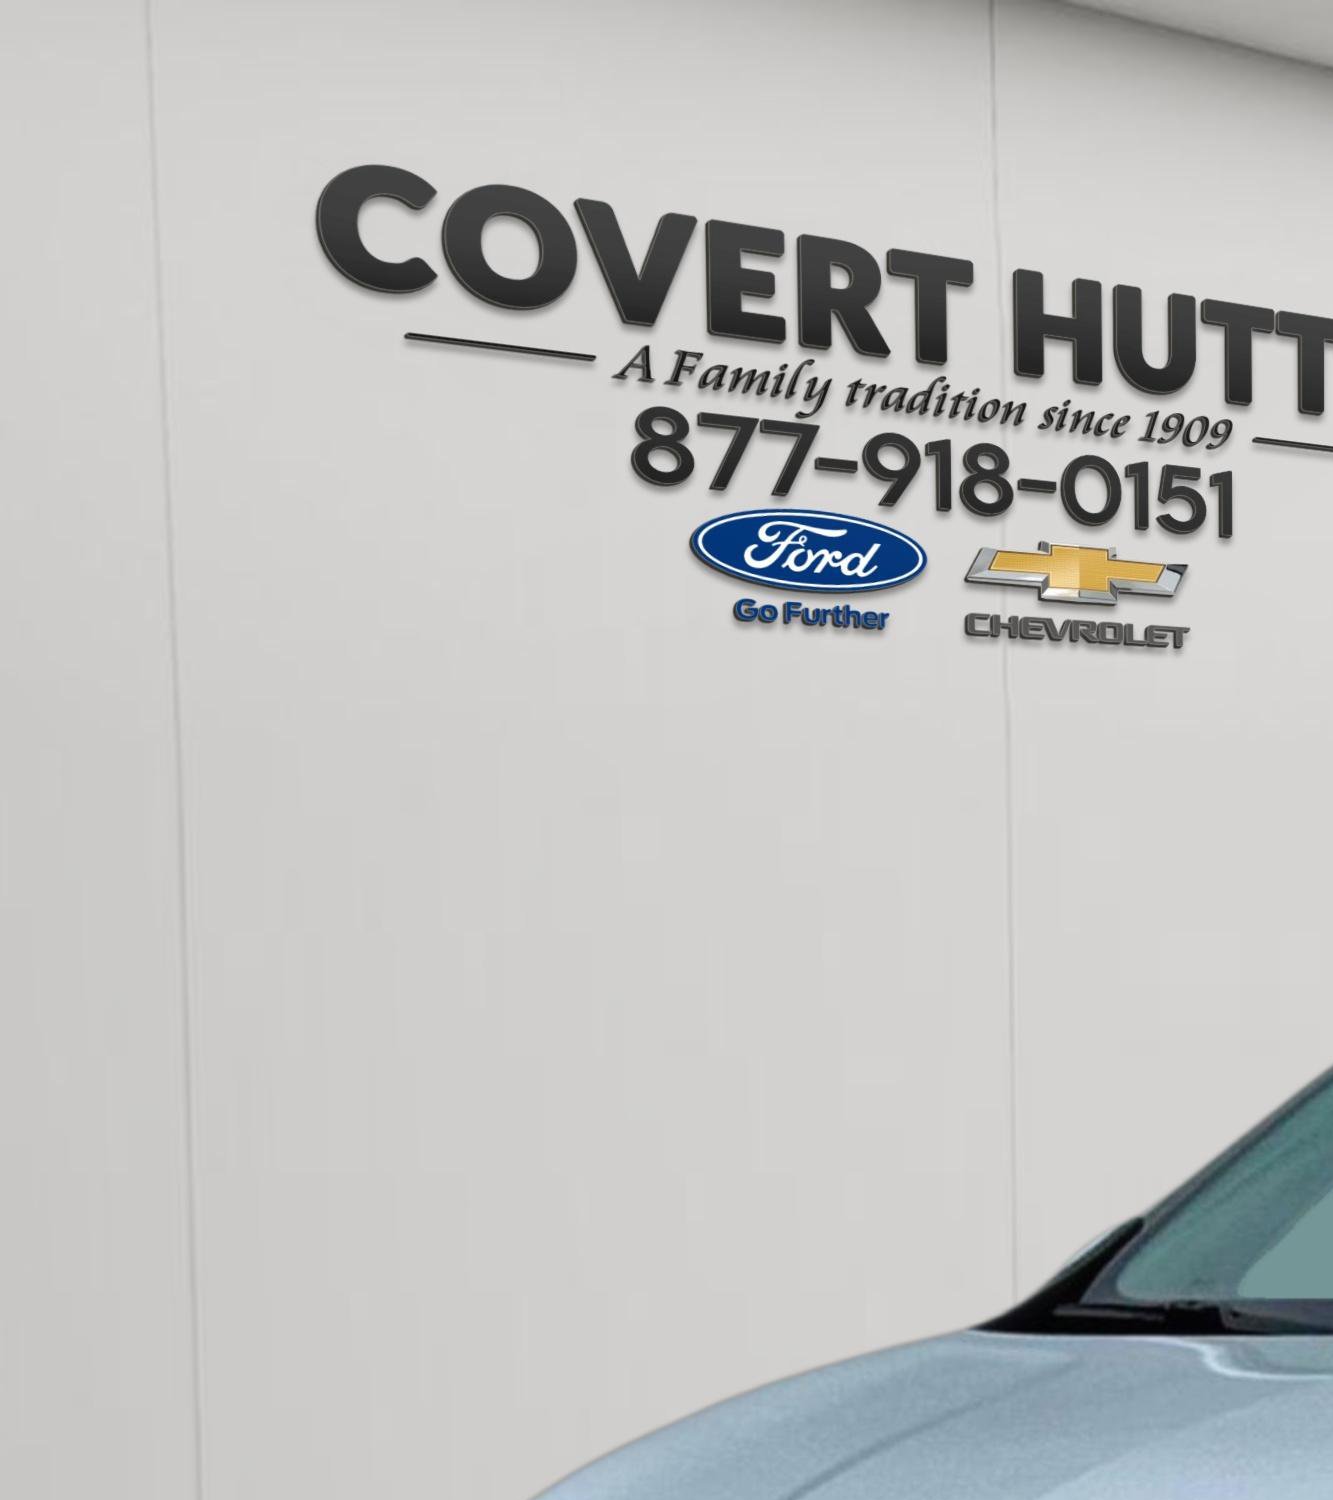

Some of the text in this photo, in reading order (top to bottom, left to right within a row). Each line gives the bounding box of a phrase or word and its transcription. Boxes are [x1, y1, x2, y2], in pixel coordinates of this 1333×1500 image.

[314, 163, 974, 368] COVERT
[611, 344, 1234, 450] A Family tradition since 1909
[629, 405, 1234, 541] 877-918-0151
[743, 520, 878, 578] Ford
[732, 598, 890, 631] Go Further
[963, 612, 1191, 650] CHEVROLET
